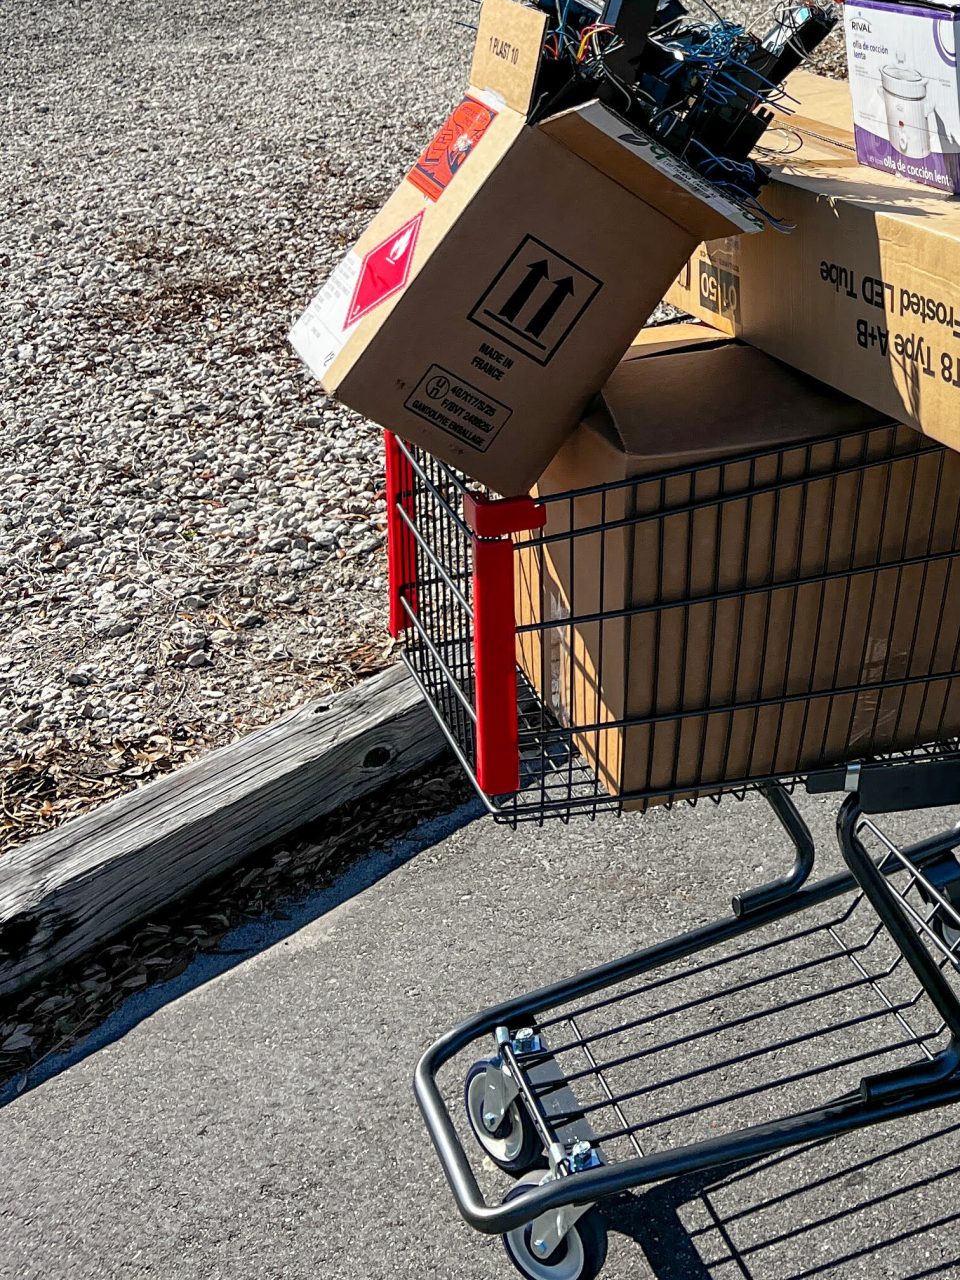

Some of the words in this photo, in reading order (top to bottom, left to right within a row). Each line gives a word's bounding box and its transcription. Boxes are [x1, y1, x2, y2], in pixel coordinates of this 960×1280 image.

[851, 21, 872, 33] RIVAL
[852, 40, 863, 49] olla
[862, 41, 869, 50] de
[869, 43, 889, 55] cocción
[853, 50, 867, 61] lenta
[884, 157, 897, 171] olla
[897, 159, 907, 174] de
[906, 163, 933, 180] cocción
[934, 167, 954, 187] lenta
[701, 272, 717, 301] 50
[820, 261, 857, 299] Tube
[723, 282, 737, 310] 01
[862, 276, 894, 313] LED
[857, 319, 889, 356] A+B
[471, 355, 505, 381] FRANCE
[479, 342, 505, 364] MADE
[503, 358, 514, 370] IN
[894, 333, 935, 378] Type
